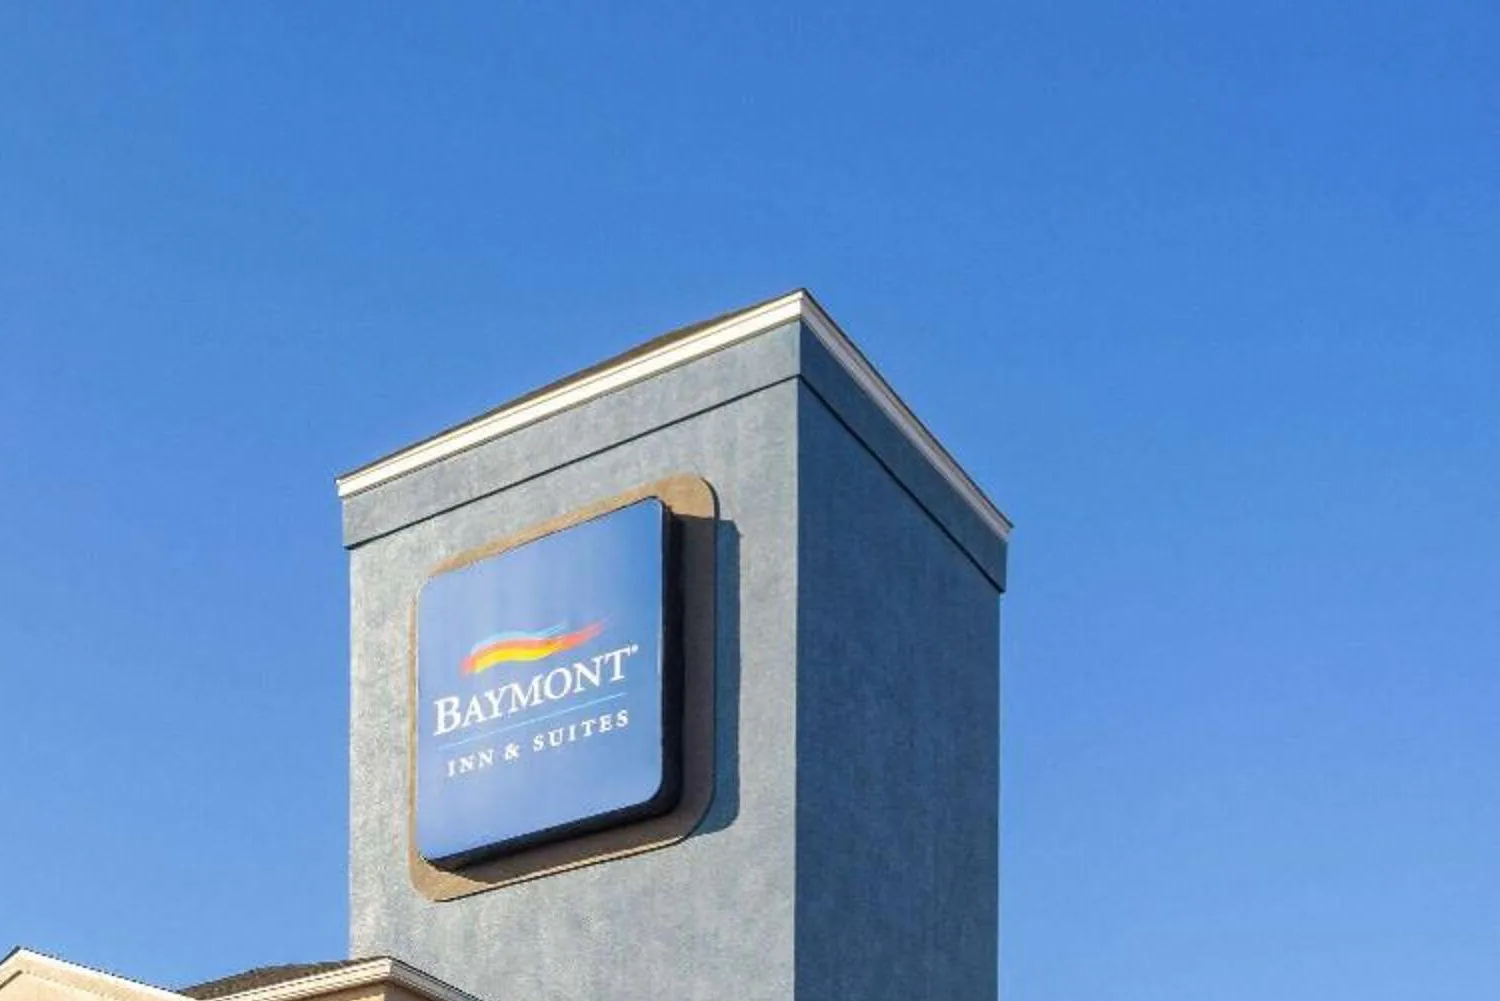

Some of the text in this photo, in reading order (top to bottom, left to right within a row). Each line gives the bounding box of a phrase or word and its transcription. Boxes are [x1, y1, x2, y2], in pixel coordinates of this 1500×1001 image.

[432, 646, 630, 737] BAYMONT
[447, 708, 630, 778] INN & SUITES
